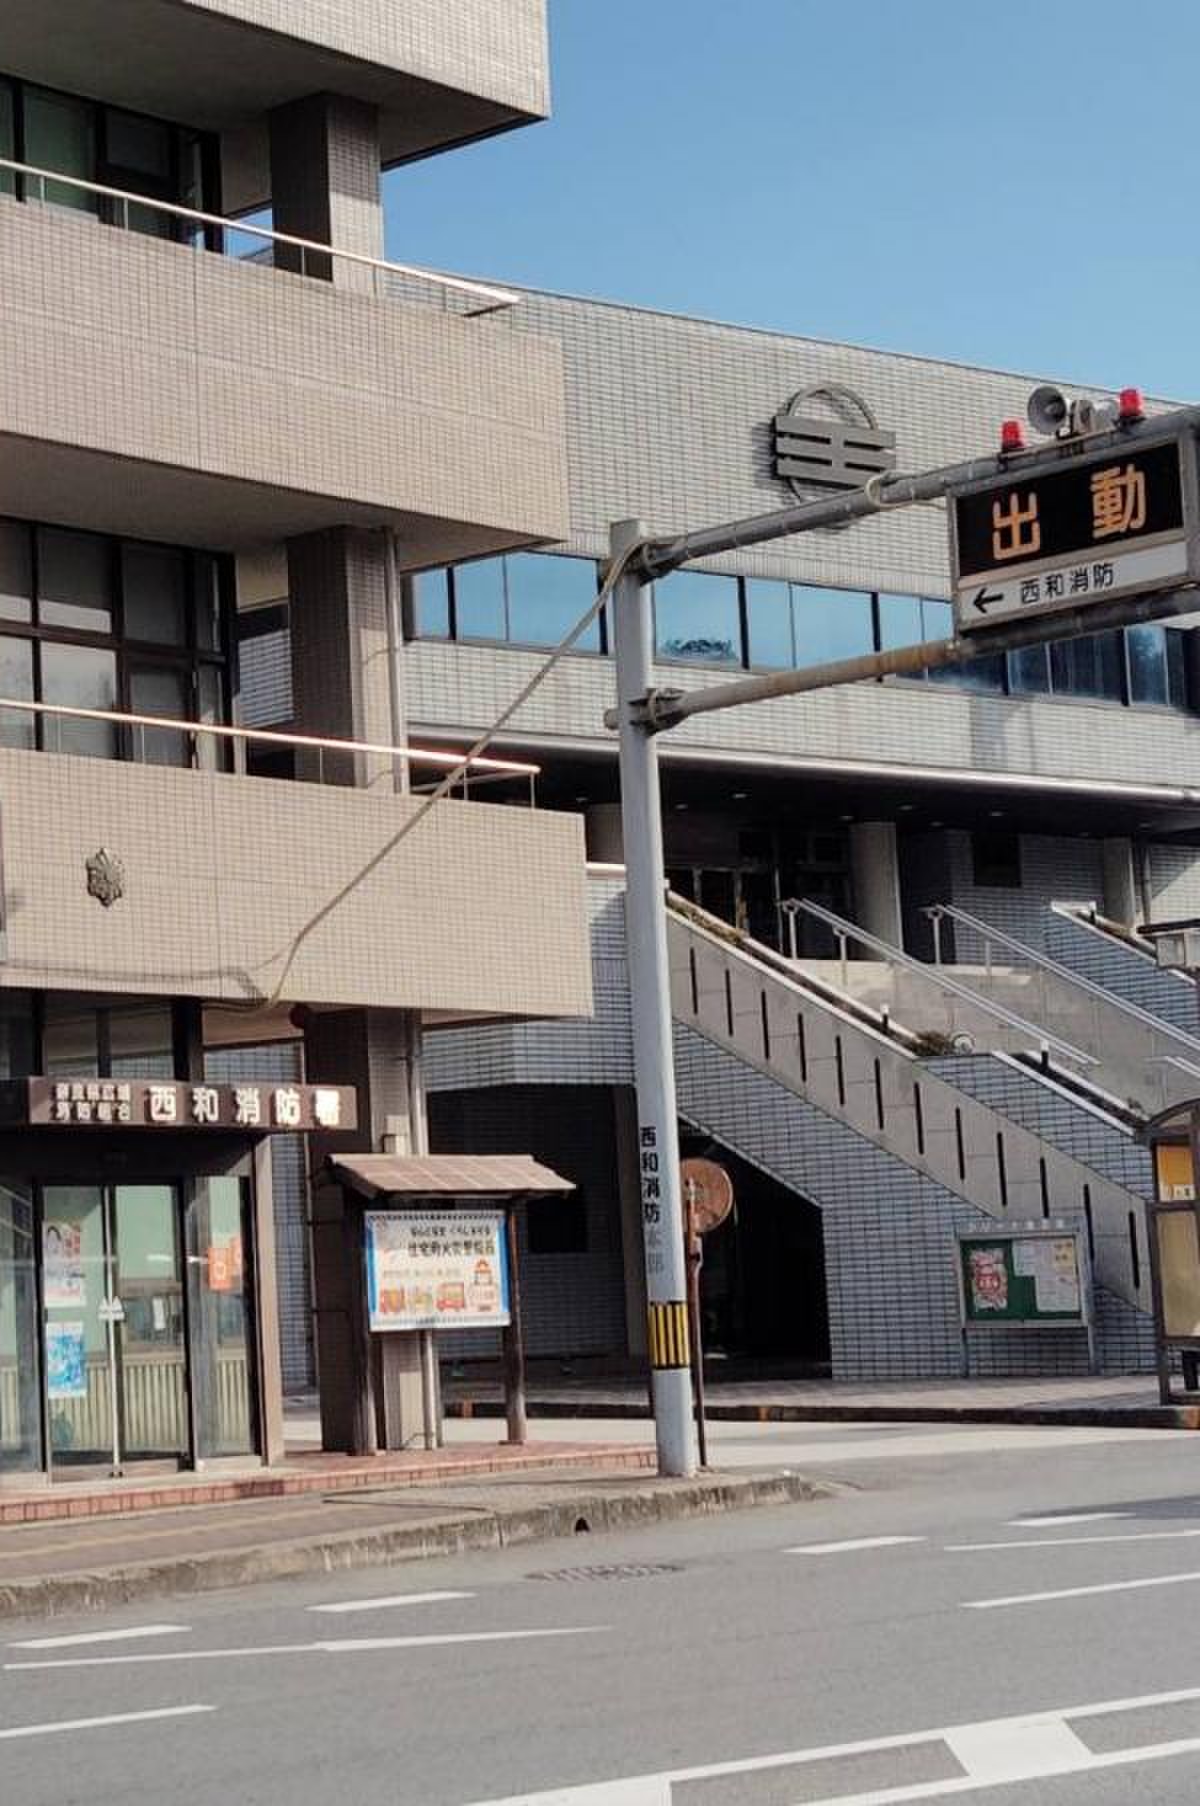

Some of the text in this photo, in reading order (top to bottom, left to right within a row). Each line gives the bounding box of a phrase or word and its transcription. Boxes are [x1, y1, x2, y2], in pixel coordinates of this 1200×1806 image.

[991, 463, 1147, 561] 出動
[1020, 562, 1115, 604] 西和消防
[149, 1085, 341, 1127] 西和消防署
